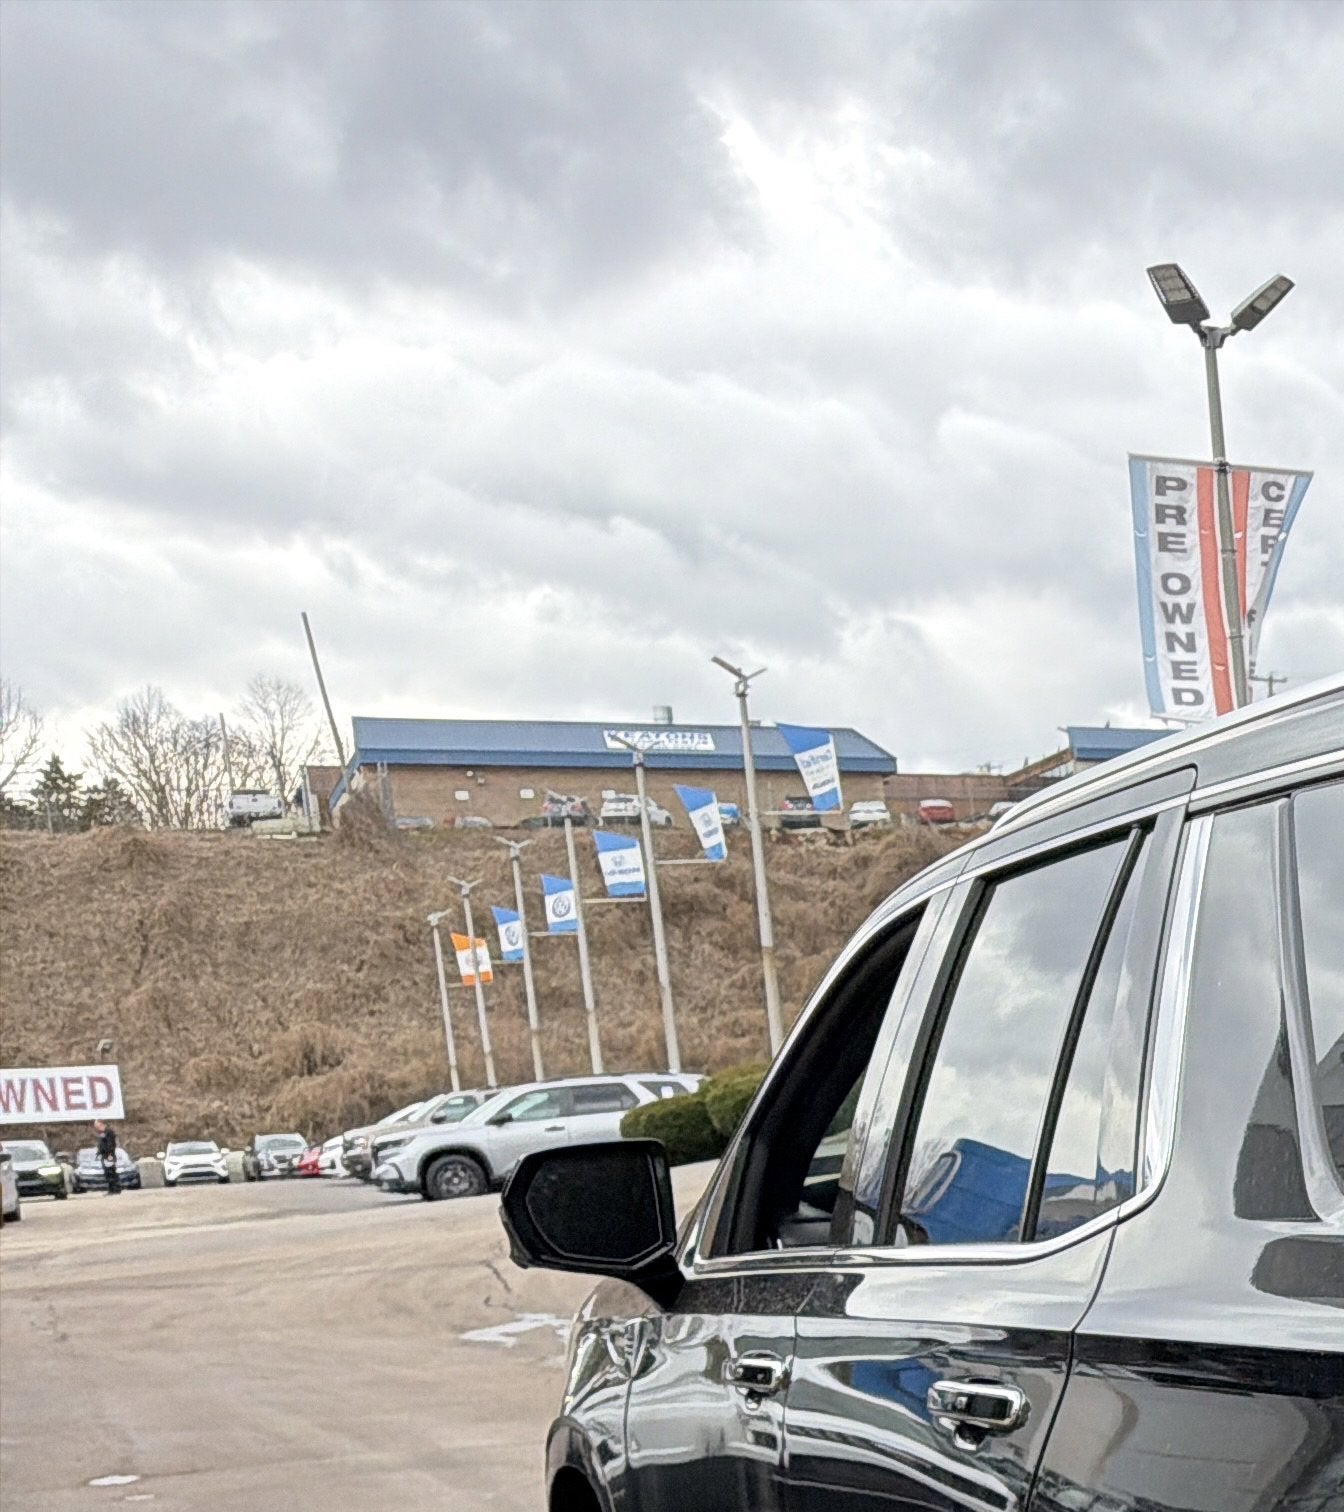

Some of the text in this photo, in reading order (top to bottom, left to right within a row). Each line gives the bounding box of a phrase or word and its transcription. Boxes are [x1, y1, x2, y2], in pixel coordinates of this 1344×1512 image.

[1154, 475, 1205, 707] PRE OWNED
[0, 1075, 114, 1114] WNED
